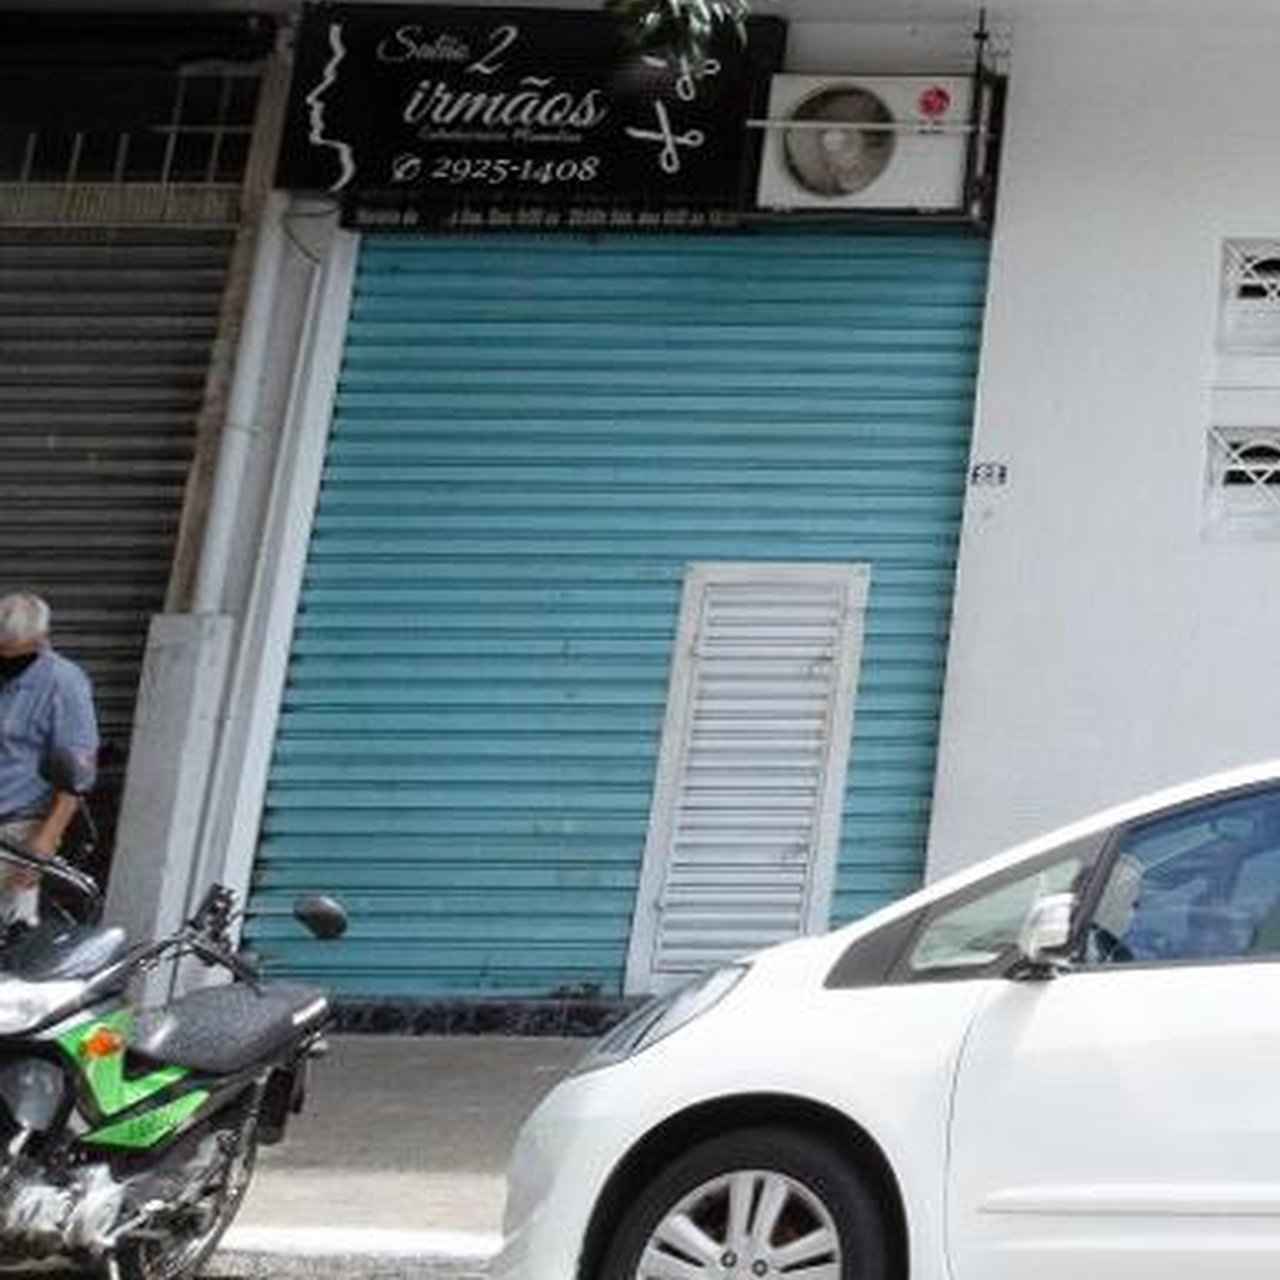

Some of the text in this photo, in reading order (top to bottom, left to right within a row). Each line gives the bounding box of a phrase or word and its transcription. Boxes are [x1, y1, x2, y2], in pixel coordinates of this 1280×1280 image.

[466, 24, 518, 74] 2
[403, 75, 607, 126] irmãos
[430, 154, 600, 185] 2925-1408
